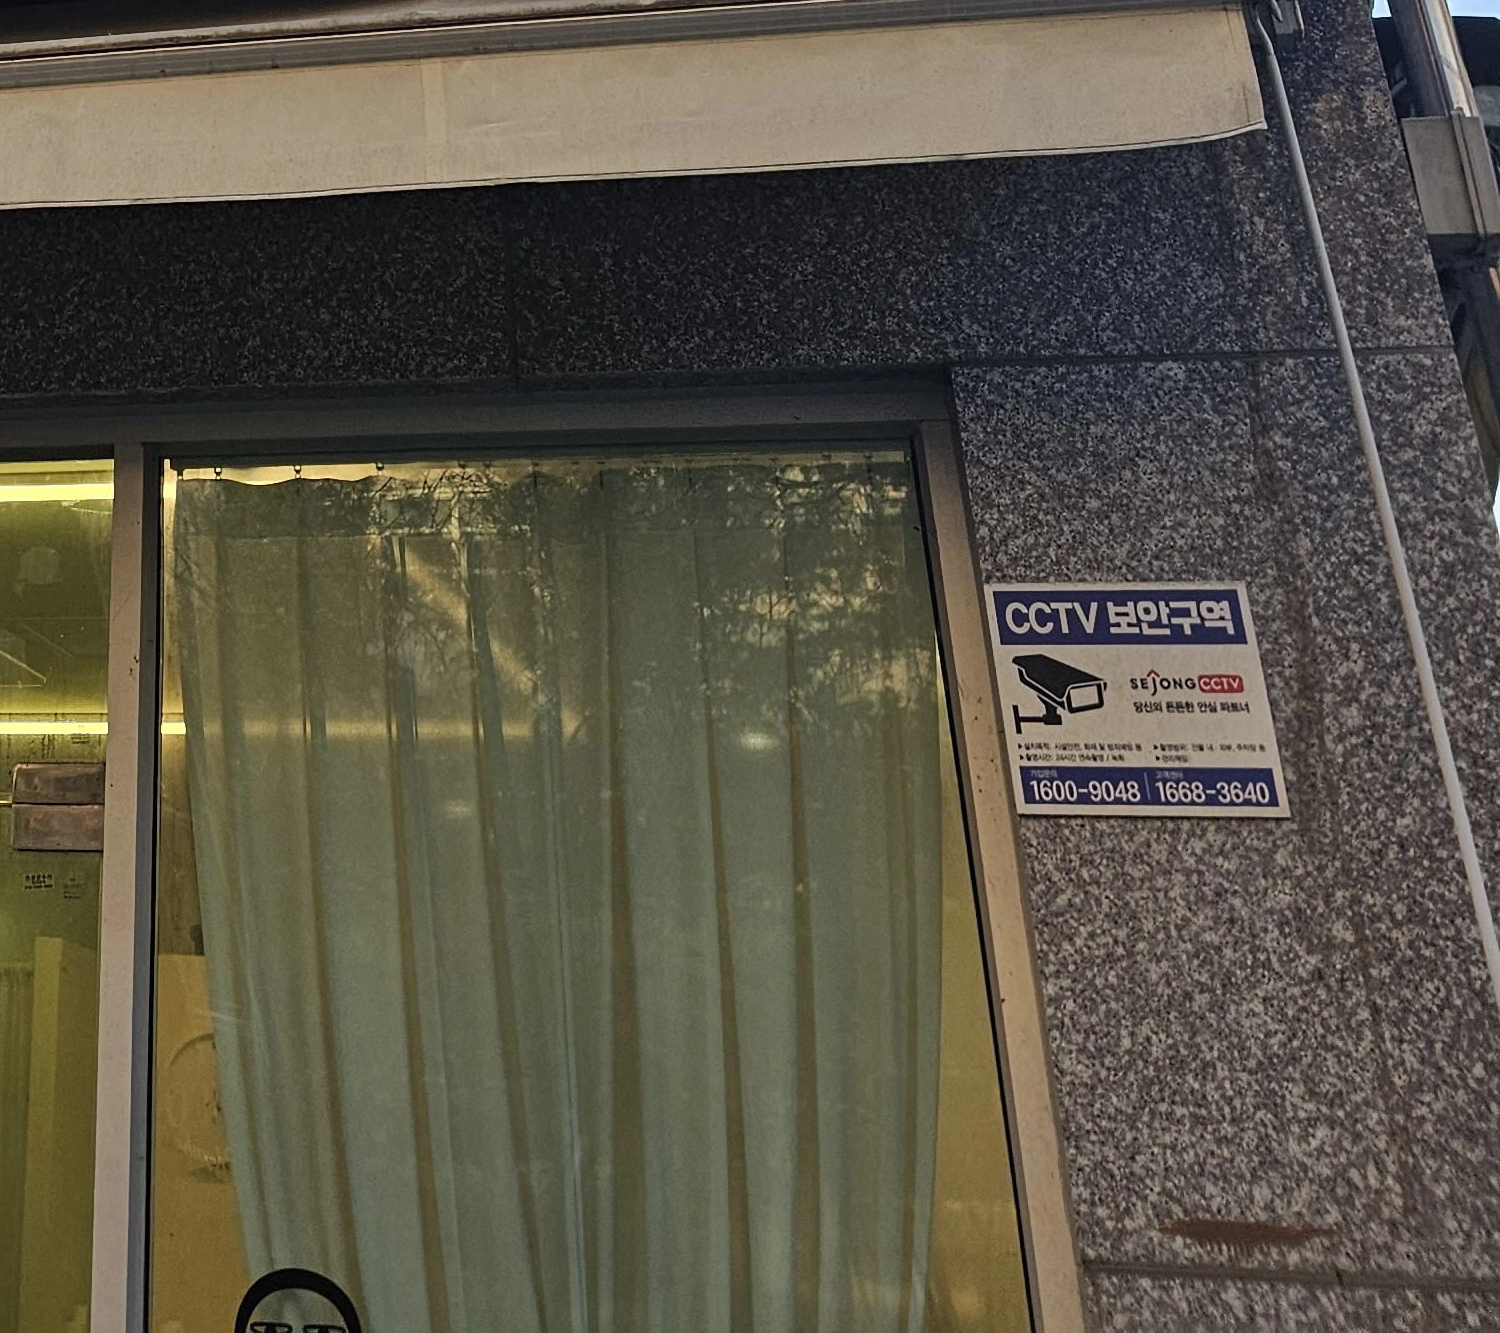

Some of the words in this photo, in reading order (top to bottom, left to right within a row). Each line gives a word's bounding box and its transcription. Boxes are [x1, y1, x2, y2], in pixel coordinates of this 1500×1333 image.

[1005, 601, 1098, 634] CCTV
[1106, 600, 1235, 635] 보안구역
[1129, 671, 1197, 696] SEJONG
[1200, 677, 1240, 691] CCTV
[1133, 701, 1163, 714] 당신의
[1197, 701, 1218, 714] 안심
[1220, 701, 1250, 714] 파트너
[1030, 780, 1141, 803] 1600-9048
[1155, 781, 1270, 804] 1668-3640
